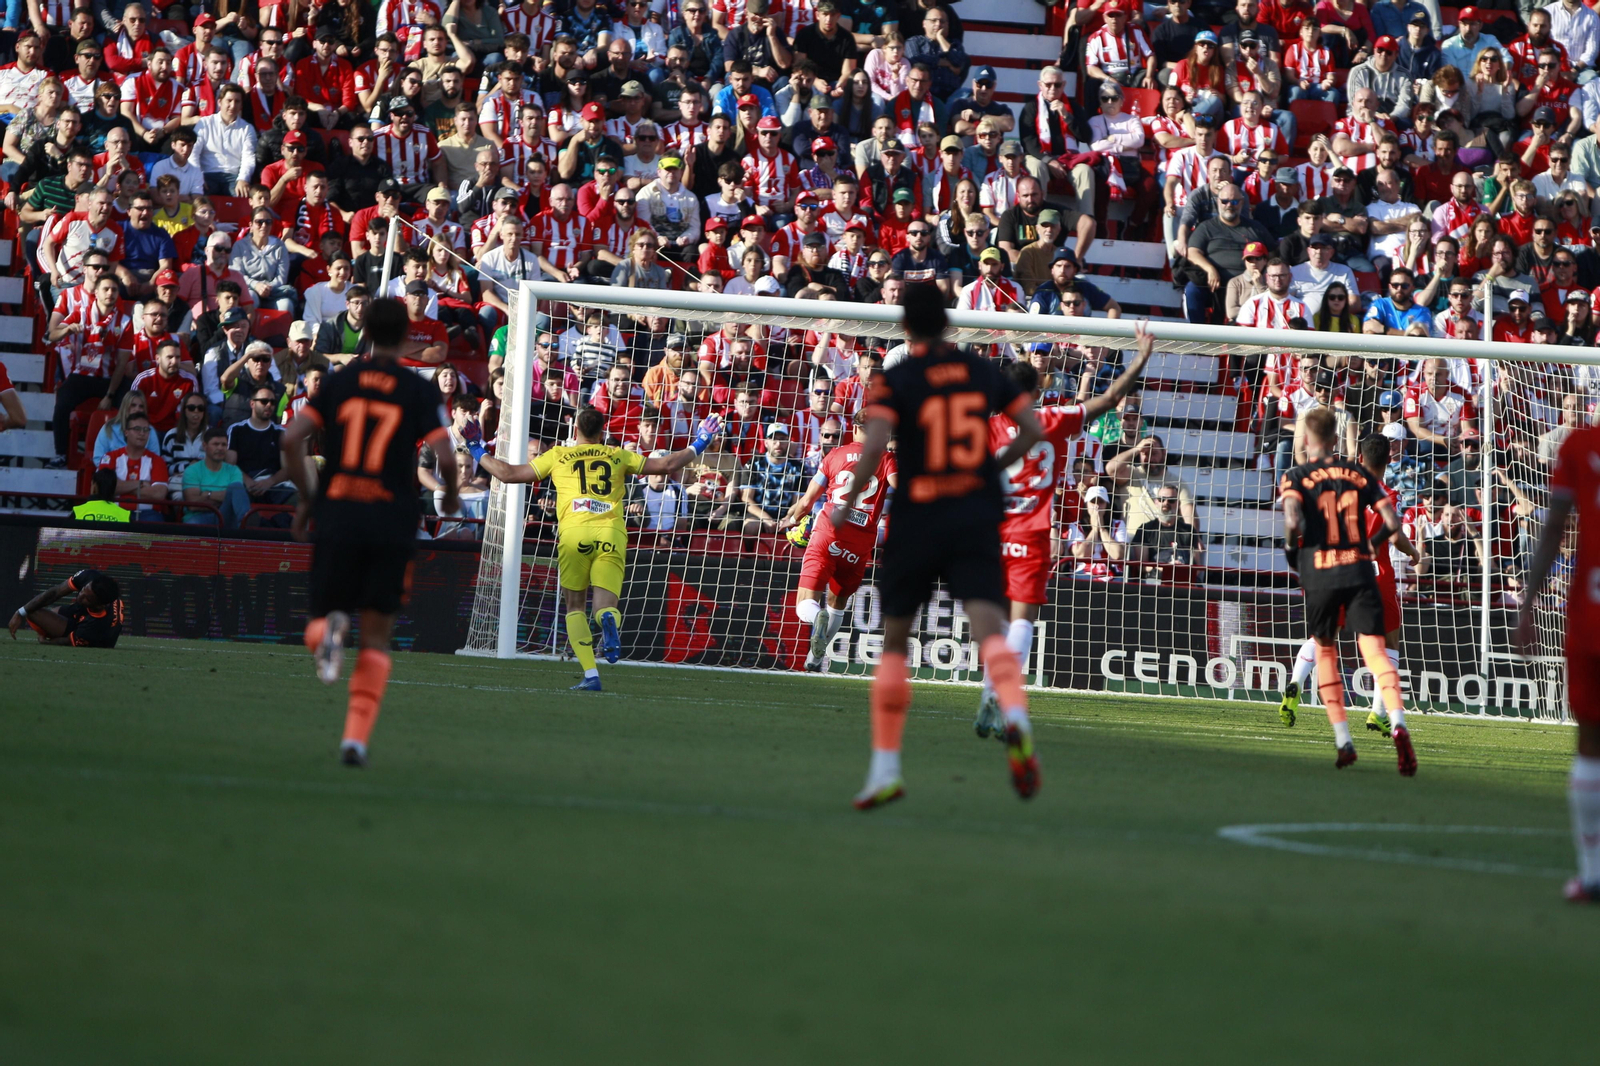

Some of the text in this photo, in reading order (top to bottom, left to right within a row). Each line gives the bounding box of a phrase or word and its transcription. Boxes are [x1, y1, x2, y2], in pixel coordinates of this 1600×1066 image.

[337, 397, 403, 473] 17
[917, 392, 987, 471] 15
[572, 460, 612, 495] 13
[831, 470, 879, 510] 22
[591, 500, 611, 509] POWER
[1317, 490, 1361, 544] 11
[593, 541, 616, 553] TCI
[842, 549, 860, 565] TCI
[1001, 542, 1028, 558] TCI
